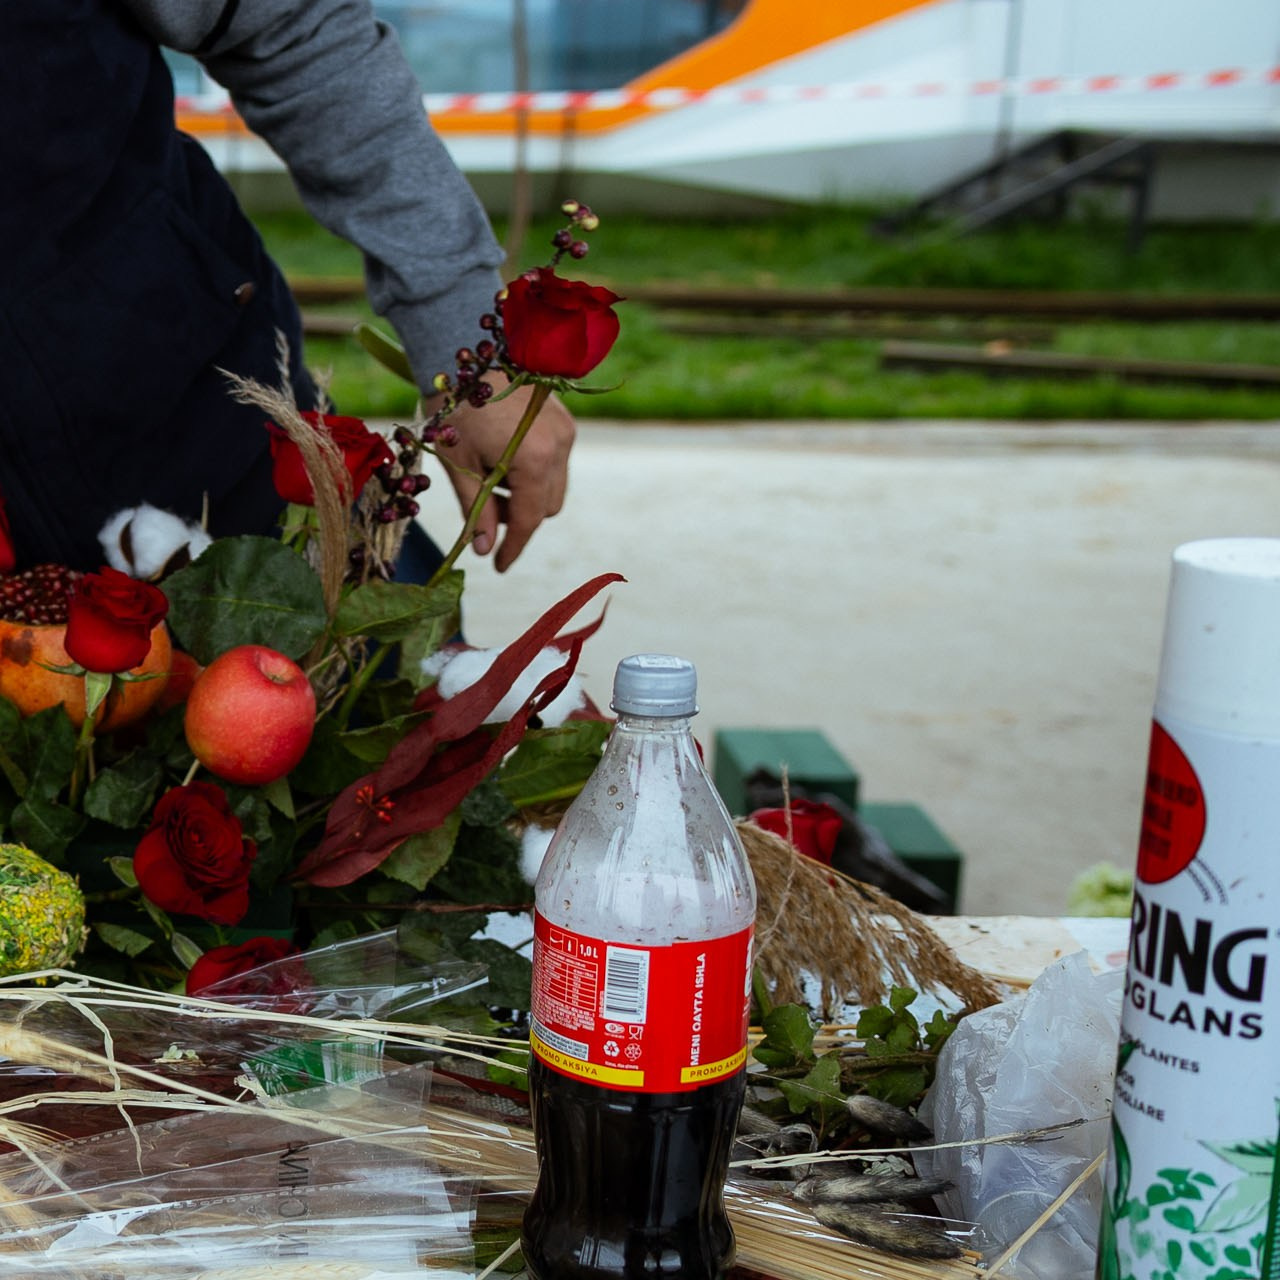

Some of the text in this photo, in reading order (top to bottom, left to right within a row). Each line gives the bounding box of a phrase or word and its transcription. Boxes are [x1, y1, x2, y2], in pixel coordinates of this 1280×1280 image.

[690, 1034, 700, 1066] MENI
[695, 953, 706, 988] ISHLA
[537, 1042, 561, 1063] PROMO
[562, 1056, 598, 1076] AKSIYA
[689, 1064, 723, 1078] PROMO
